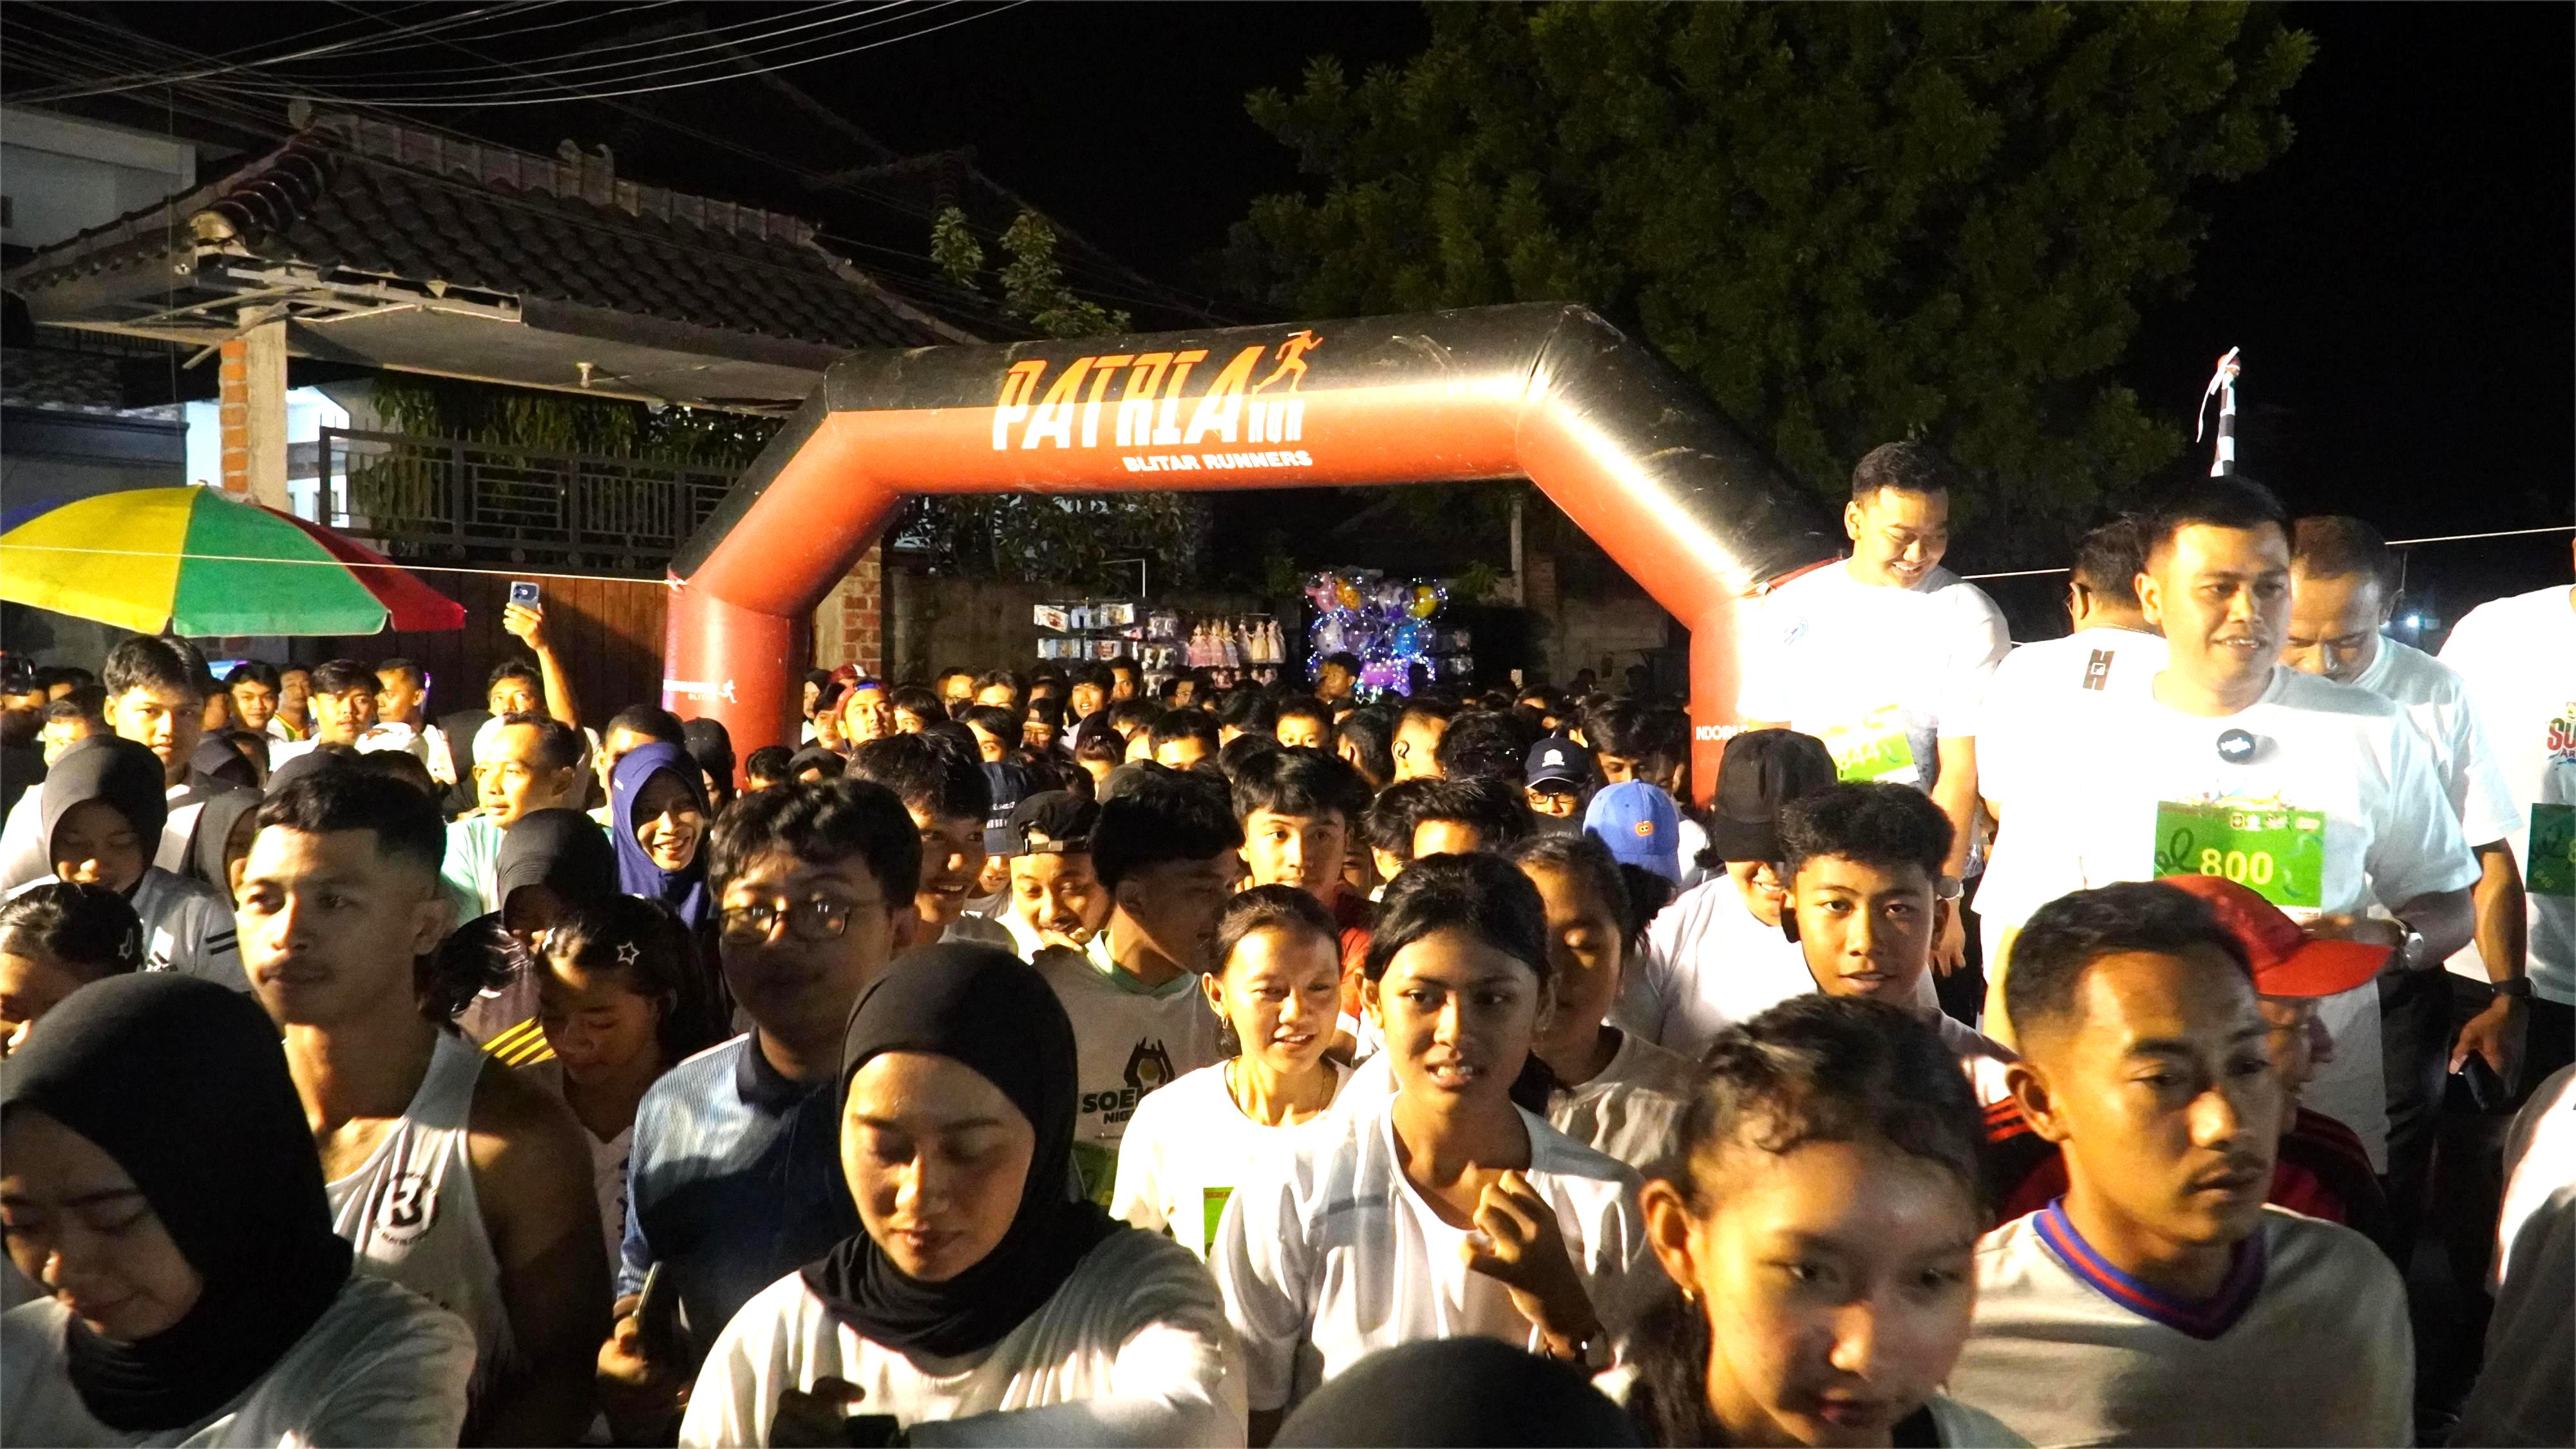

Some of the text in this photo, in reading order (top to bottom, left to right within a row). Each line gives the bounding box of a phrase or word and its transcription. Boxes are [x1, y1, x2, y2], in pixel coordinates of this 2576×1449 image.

[992, 346, 1266, 450] PATRIA
[1122, 450, 1313, 472] BLITAR RUNNERS
[2199, 848, 2273, 885] 800
